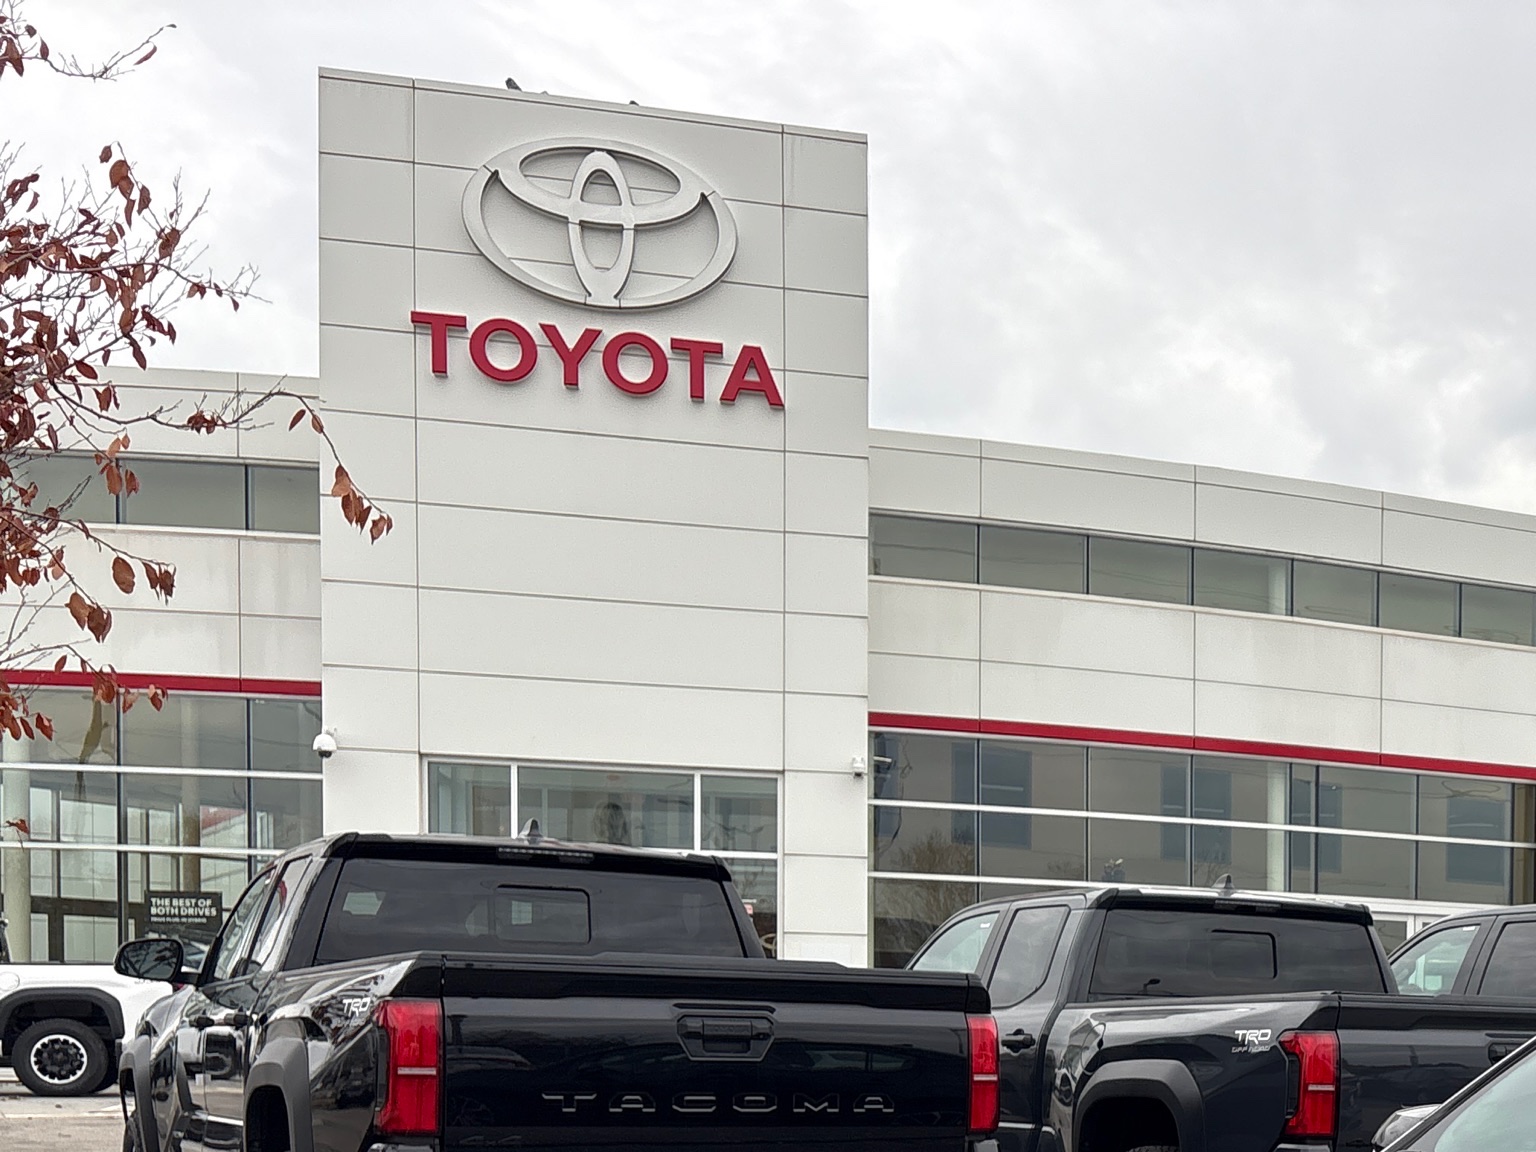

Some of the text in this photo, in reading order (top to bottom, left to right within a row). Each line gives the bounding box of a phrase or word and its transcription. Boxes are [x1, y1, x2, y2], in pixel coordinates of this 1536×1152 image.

[410, 310, 785, 410] TOYOTA
[150, 897, 212, 908] THE BEST OF
[150, 907, 217, 917] BOTH DRIVES
[342, 997, 371, 1017] TRD
[1234, 1029, 1271, 1045] TRD
[541, 1090, 895, 1113] TACOMA
